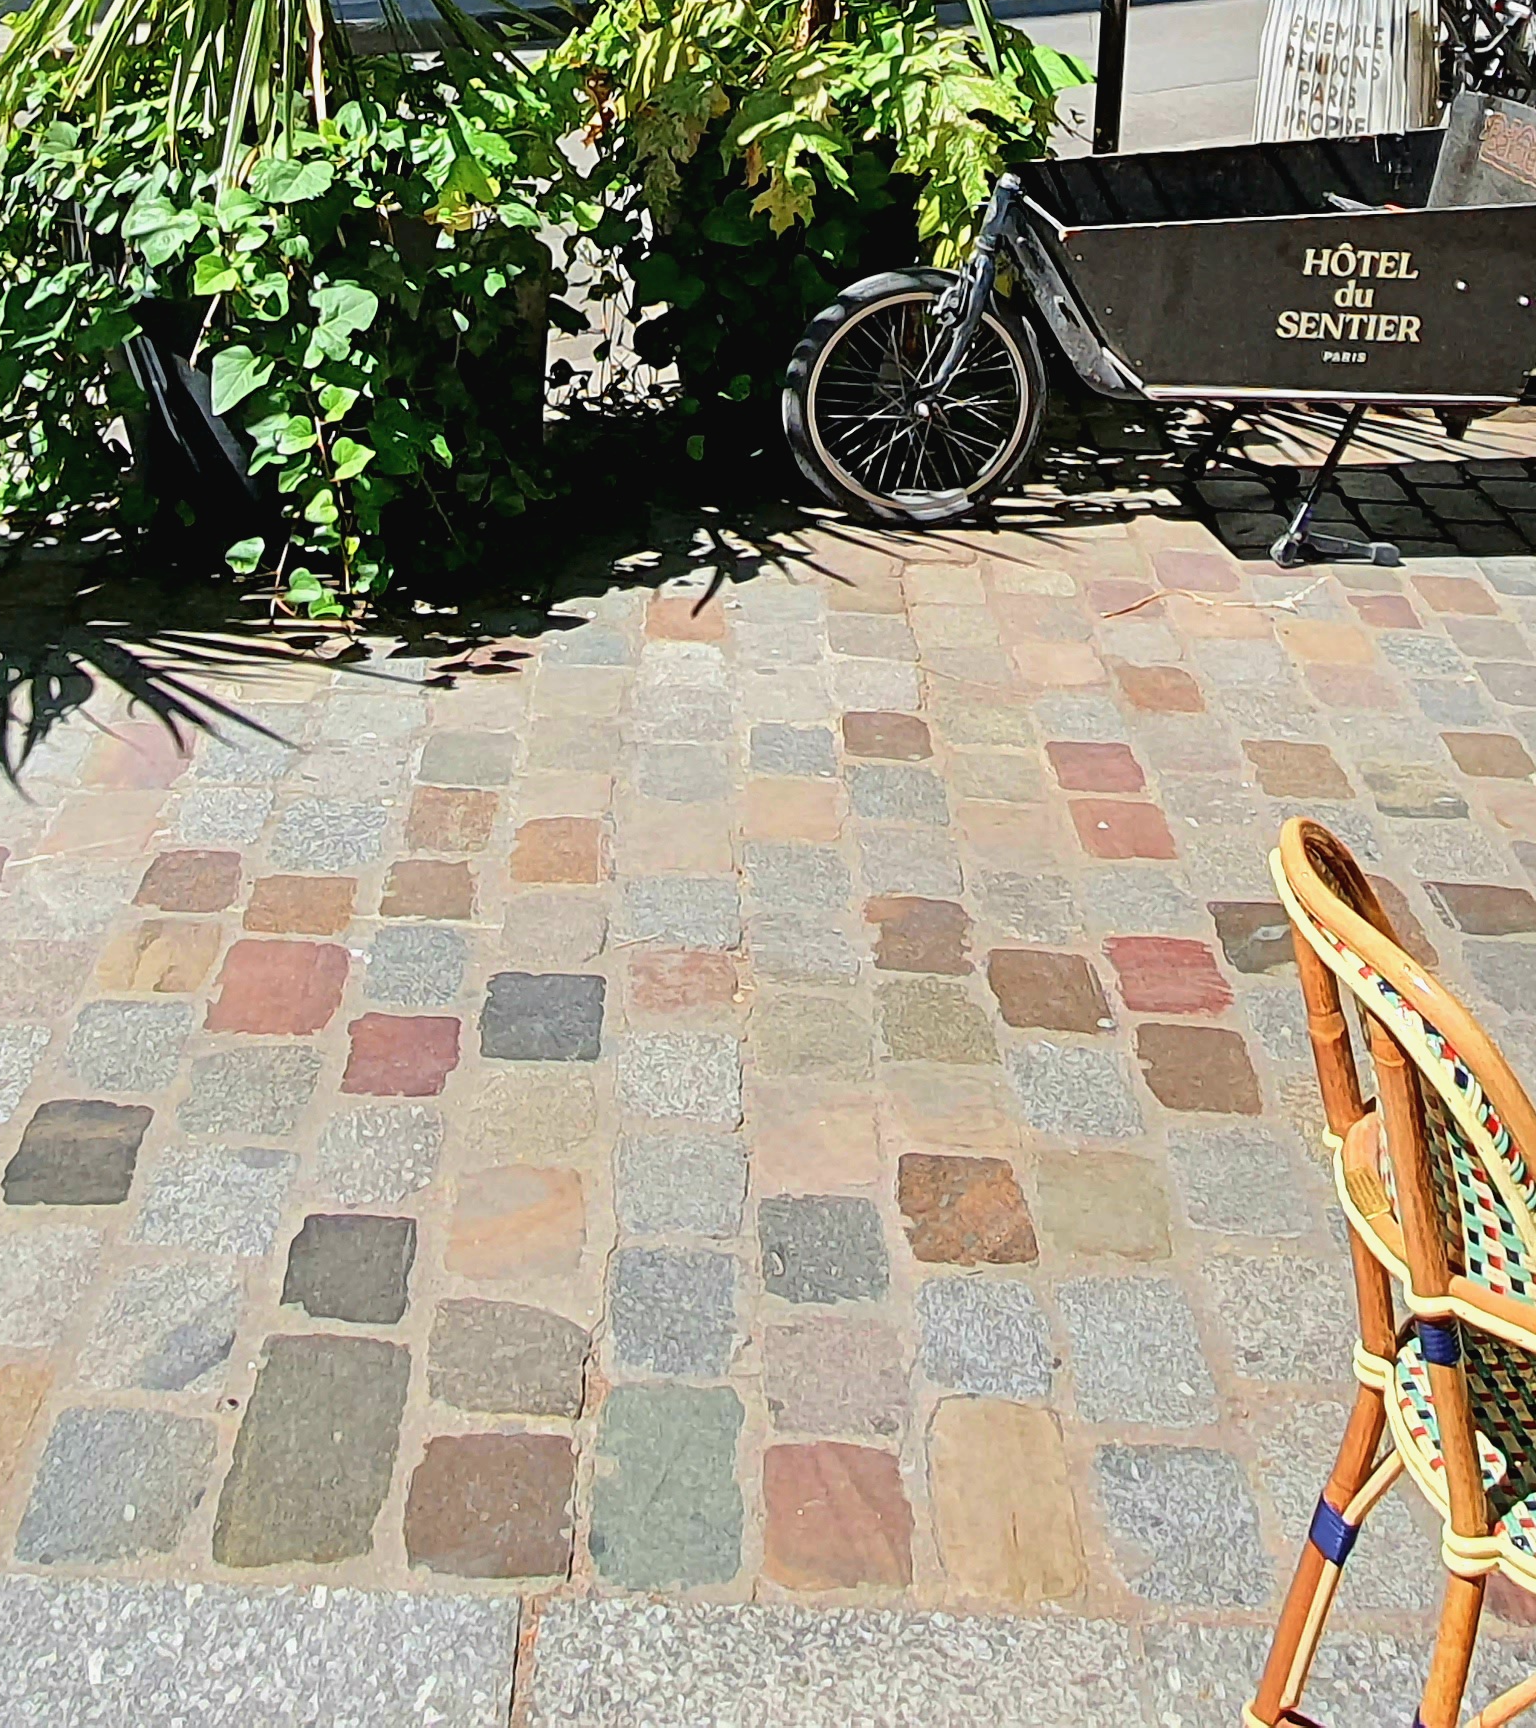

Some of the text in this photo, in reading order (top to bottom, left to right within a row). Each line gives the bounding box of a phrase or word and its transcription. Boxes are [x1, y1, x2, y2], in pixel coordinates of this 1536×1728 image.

[1297, 79, 1357, 109] PARIS
[1302, 242, 1419, 279] HÔTEL
[1333, 279, 1375, 308] du
[1275, 310, 1421, 343] SENTIER
[1322, 350, 1367, 363] PARIS
